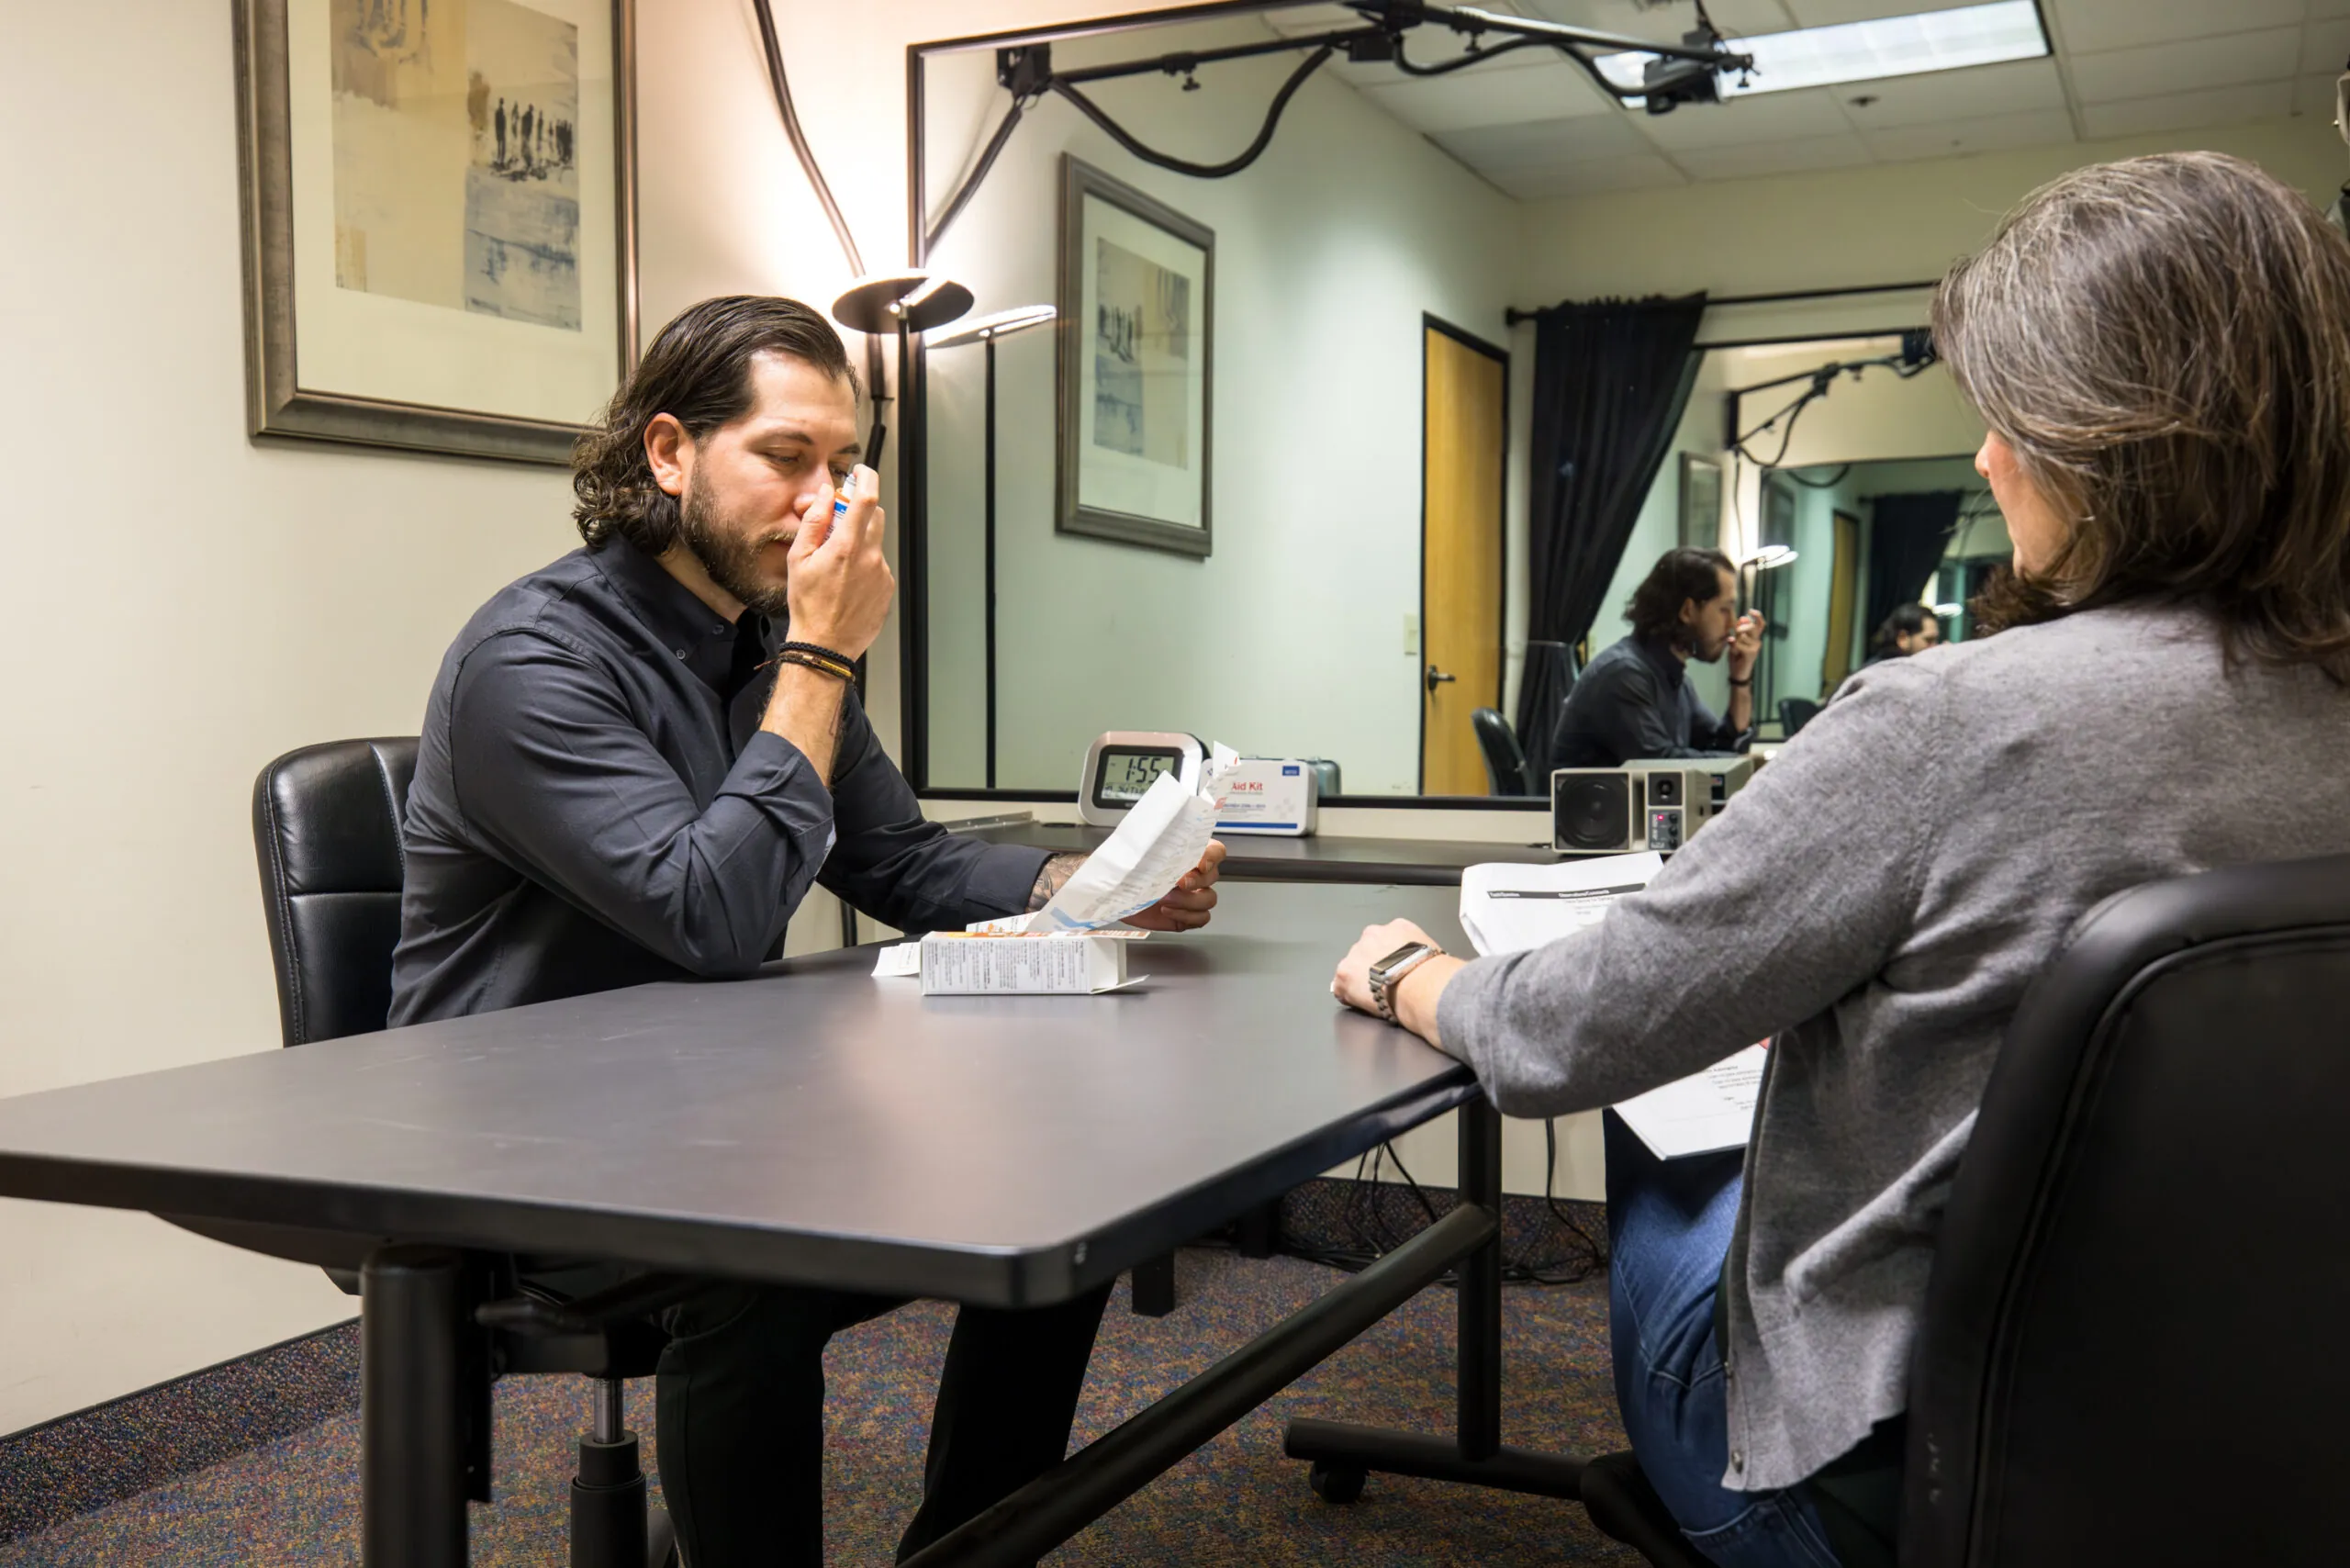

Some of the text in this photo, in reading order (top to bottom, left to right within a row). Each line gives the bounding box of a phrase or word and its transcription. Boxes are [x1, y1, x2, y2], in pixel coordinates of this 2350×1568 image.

[1125, 756, 1162, 783] 1:55
[1231, 781, 1264, 791] Aid Kit
